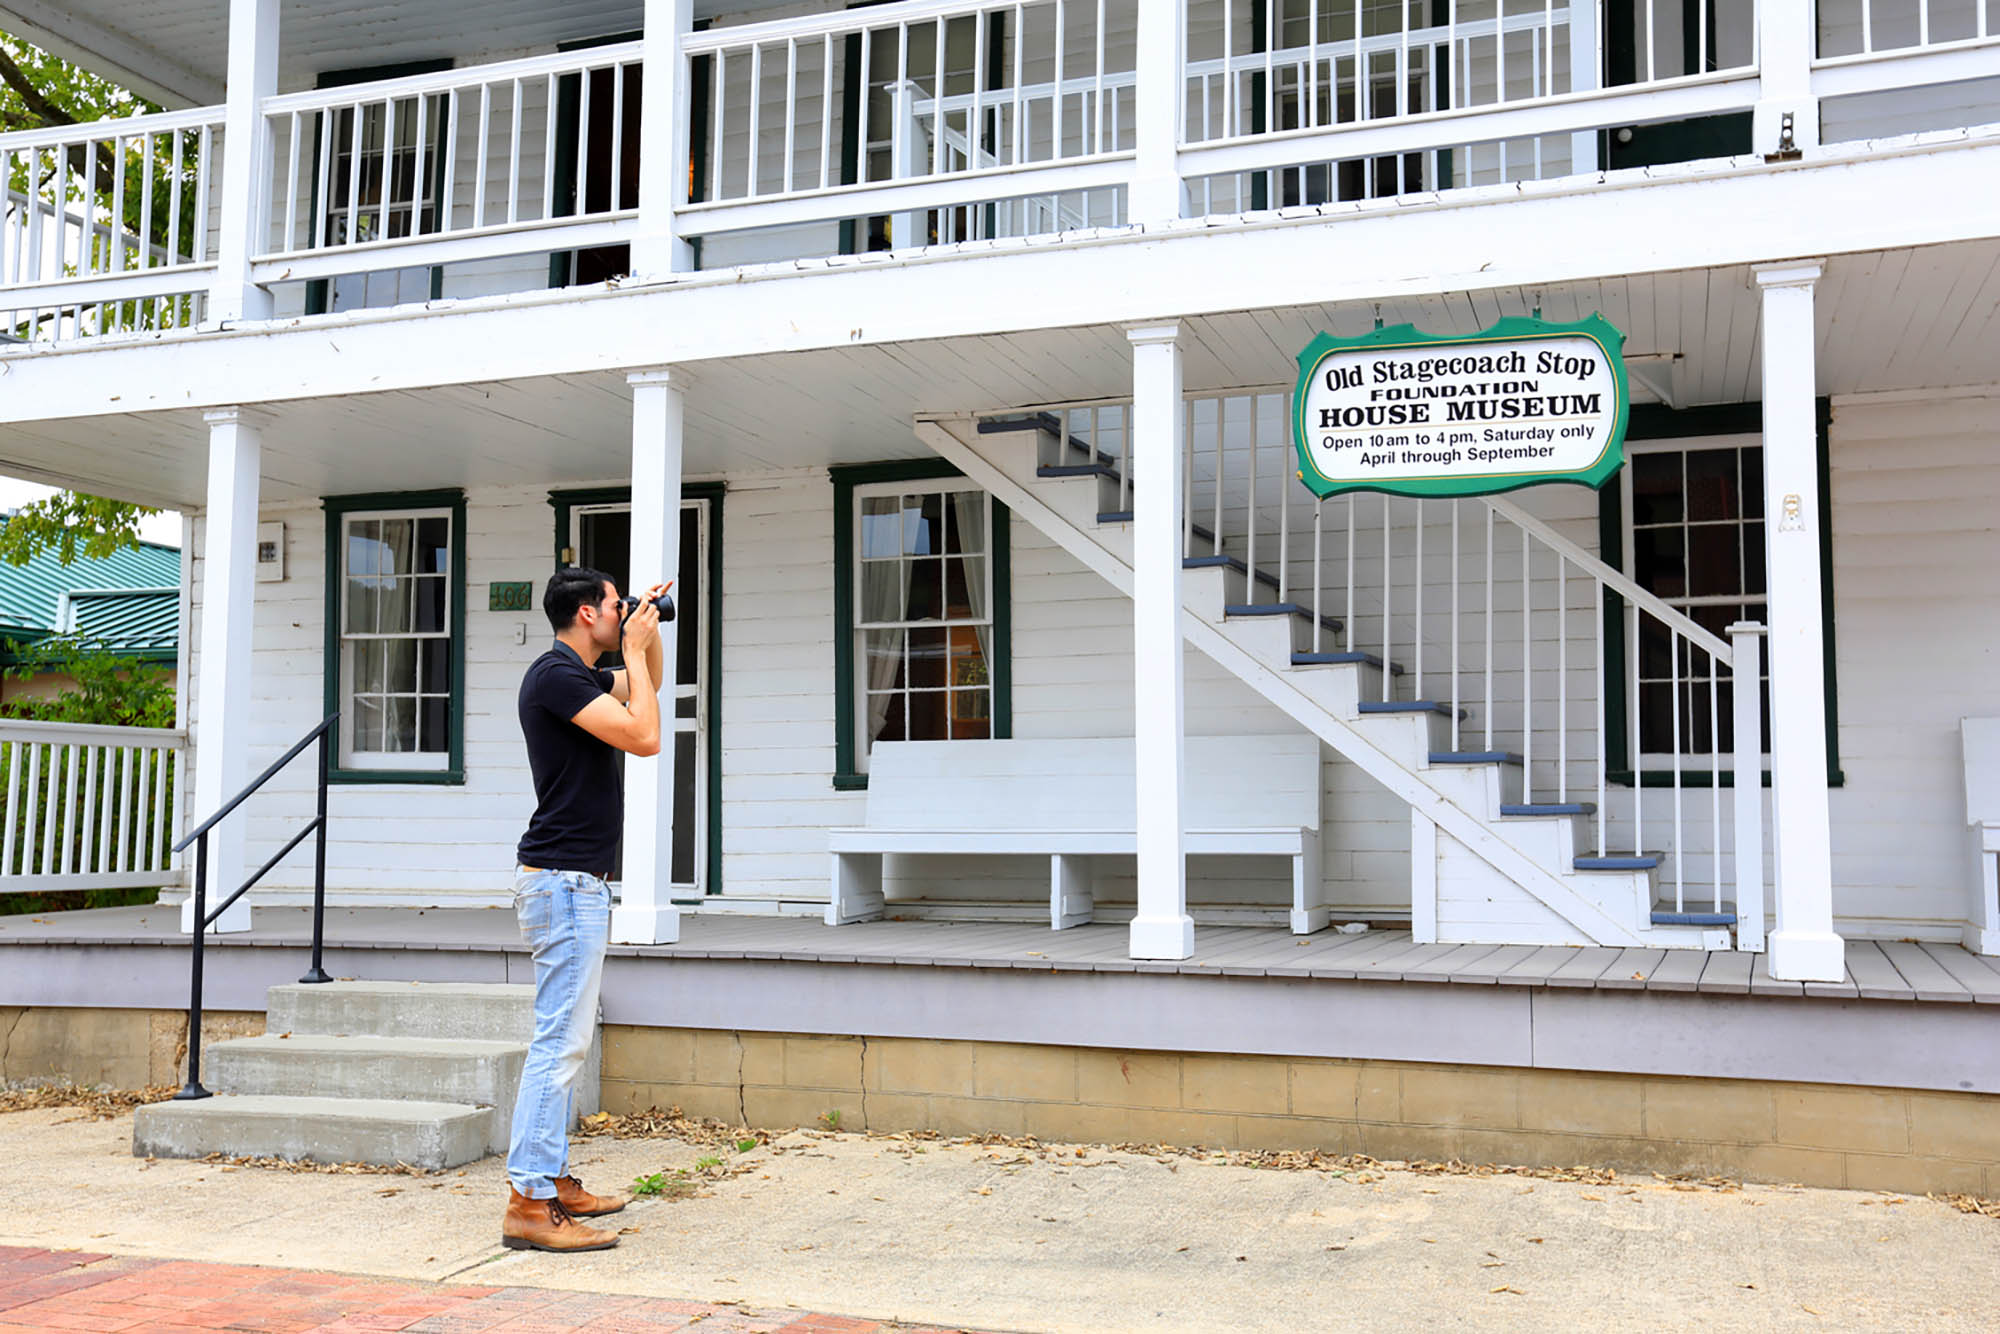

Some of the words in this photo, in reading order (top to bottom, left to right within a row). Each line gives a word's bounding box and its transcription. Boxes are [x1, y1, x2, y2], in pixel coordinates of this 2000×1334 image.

[1325, 364, 1364, 392] Old
[1372, 350, 1526, 384] Stagecoach
[1536, 350, 1596, 381] Stop
[1370, 380, 1539, 402] FOUNDATION
[1318, 403, 1430, 429] HOUSE
[1446, 393, 1602, 422] MUSEUM
[1322, 435, 1363, 452] Open
[1415, 433, 1431, 445] to
[1483, 426, 1555, 442] Saturday
[1560, 423, 1595, 440] only
[1360, 451, 1396, 468] April
[1401, 448, 1462, 465] through
[1467, 444, 1555, 463] September
